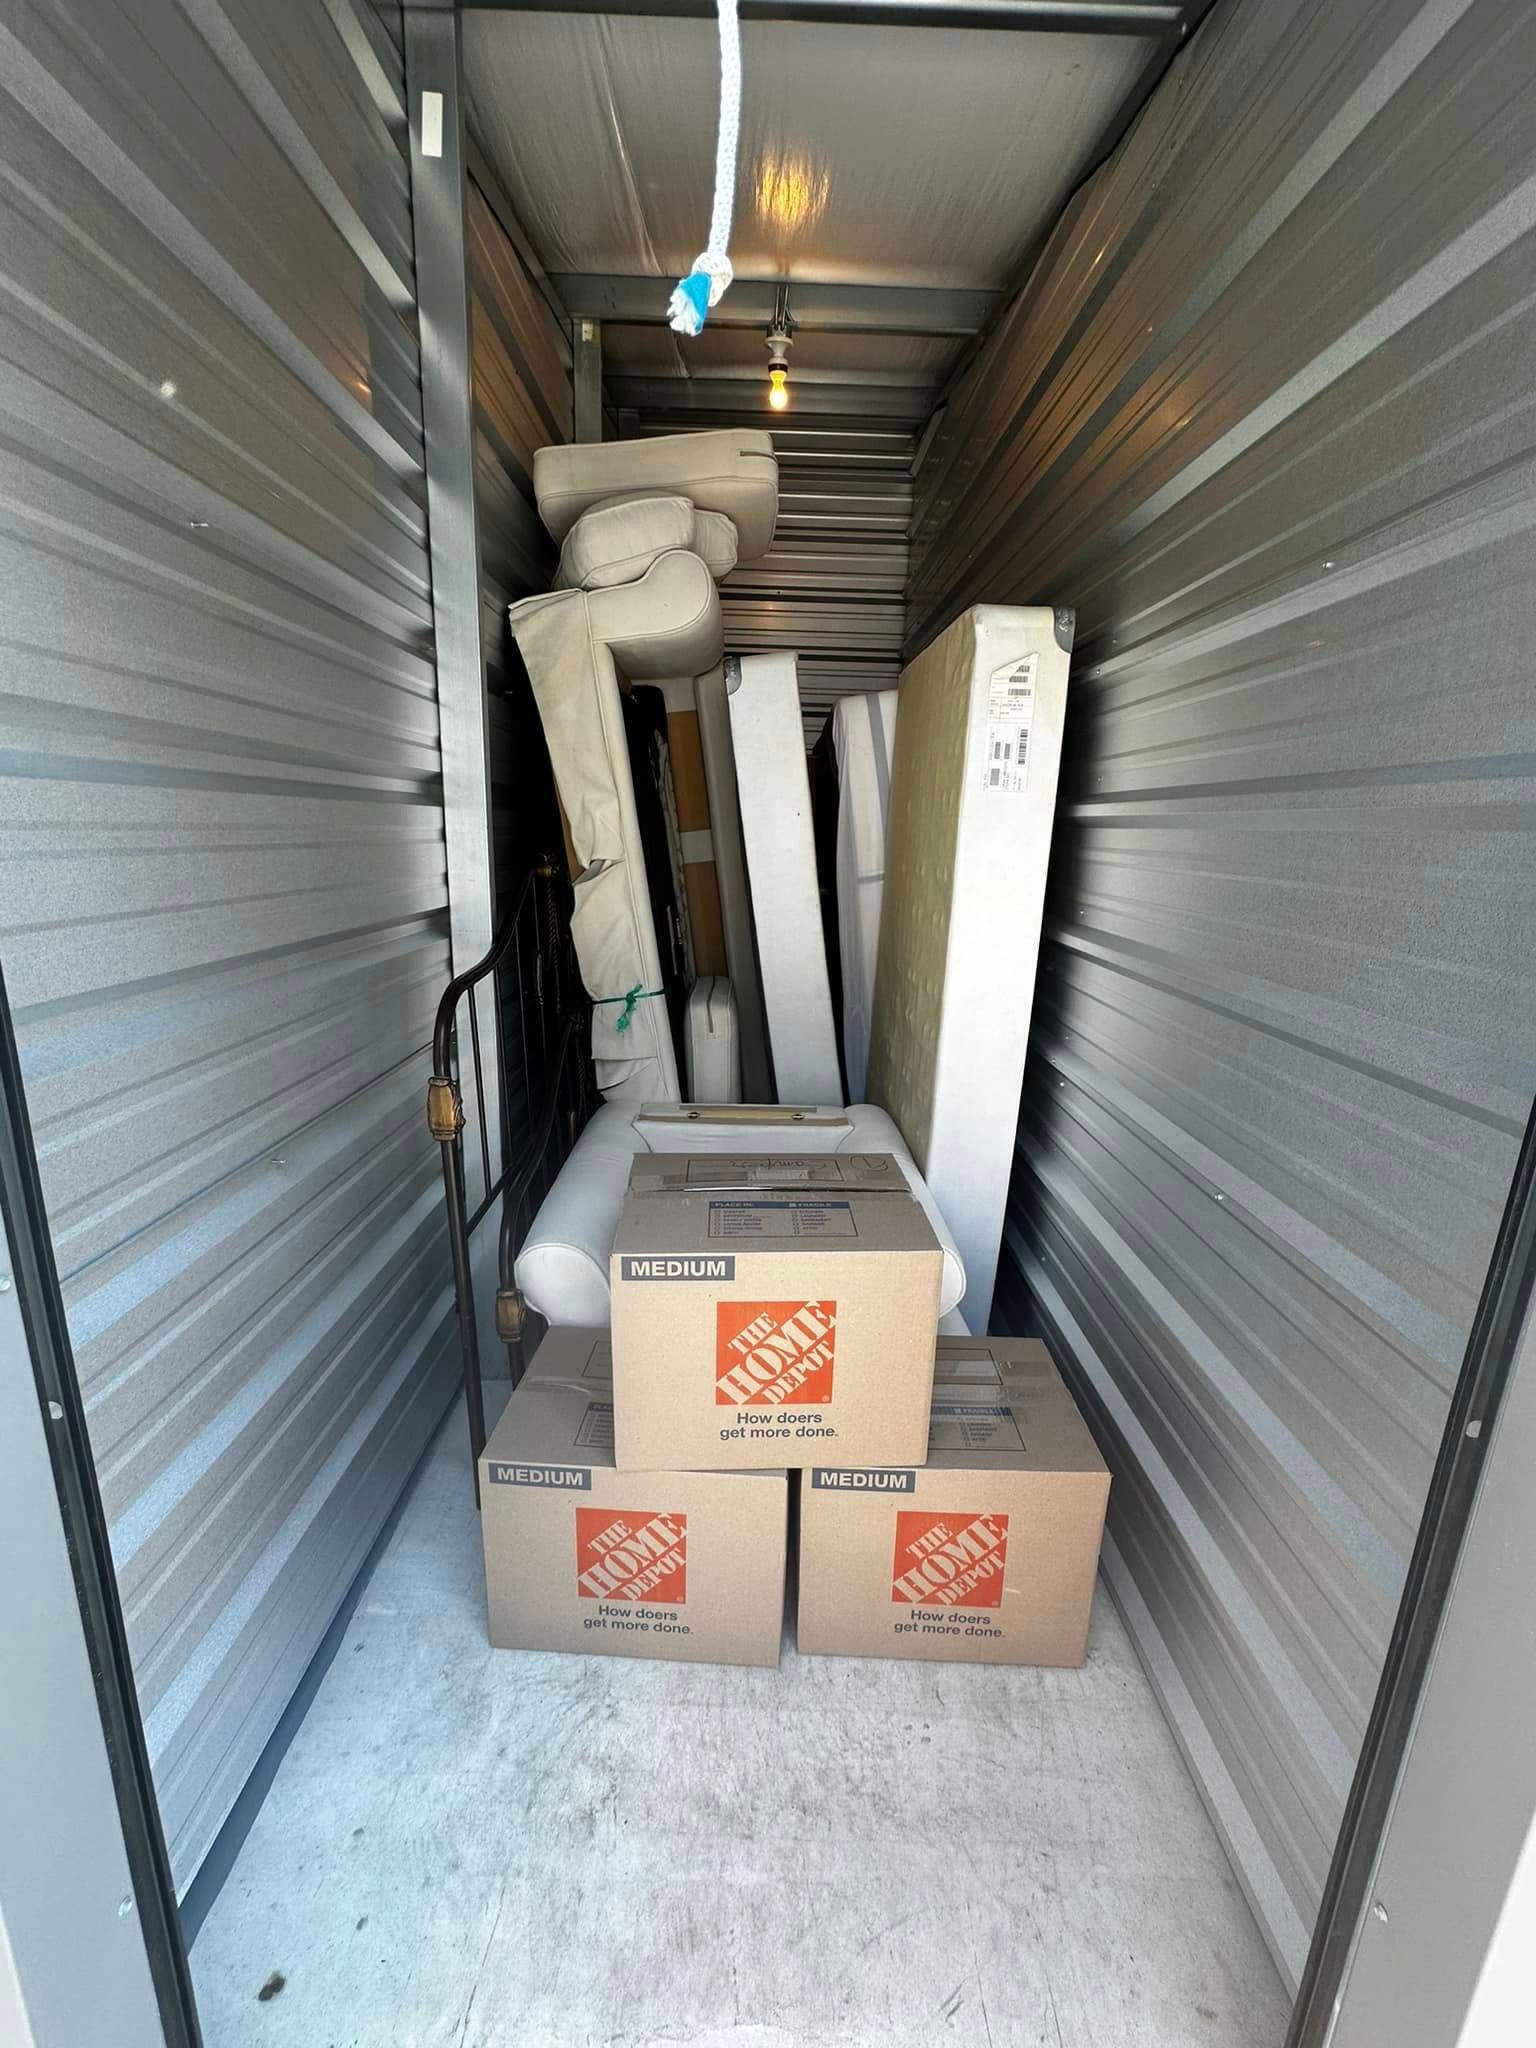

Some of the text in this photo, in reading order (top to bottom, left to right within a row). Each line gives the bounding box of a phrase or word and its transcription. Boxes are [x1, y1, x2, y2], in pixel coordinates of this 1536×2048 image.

[630, 1260, 726, 1277] MEDIUM
[728, 1311, 778, 1354] THE
[715, 1300, 838, 1405] HOME
[761, 1340, 834, 1404] DEPOT
[736, 1412, 822, 1424] How doers
[719, 1425, 839, 1440] get more done.
[497, 1468, 583, 1486] MEDIUM
[820, 1472, 907, 1489] MEDIUM
[587, 1520, 632, 1554] THE
[905, 1523, 952, 1558] THE
[576, 1513, 687, 1599] HOME
[893, 1513, 1008, 1604] HOME
[620, 1549, 686, 1601] DEPOT
[934, 1551, 1006, 1606] DEPOT
[583, 1617, 694, 1634] get more done.
[599, 1605, 678, 1620] How doers
[911, 1610, 991, 1625] How doers
[894, 1620, 1006, 1638] get more done.
